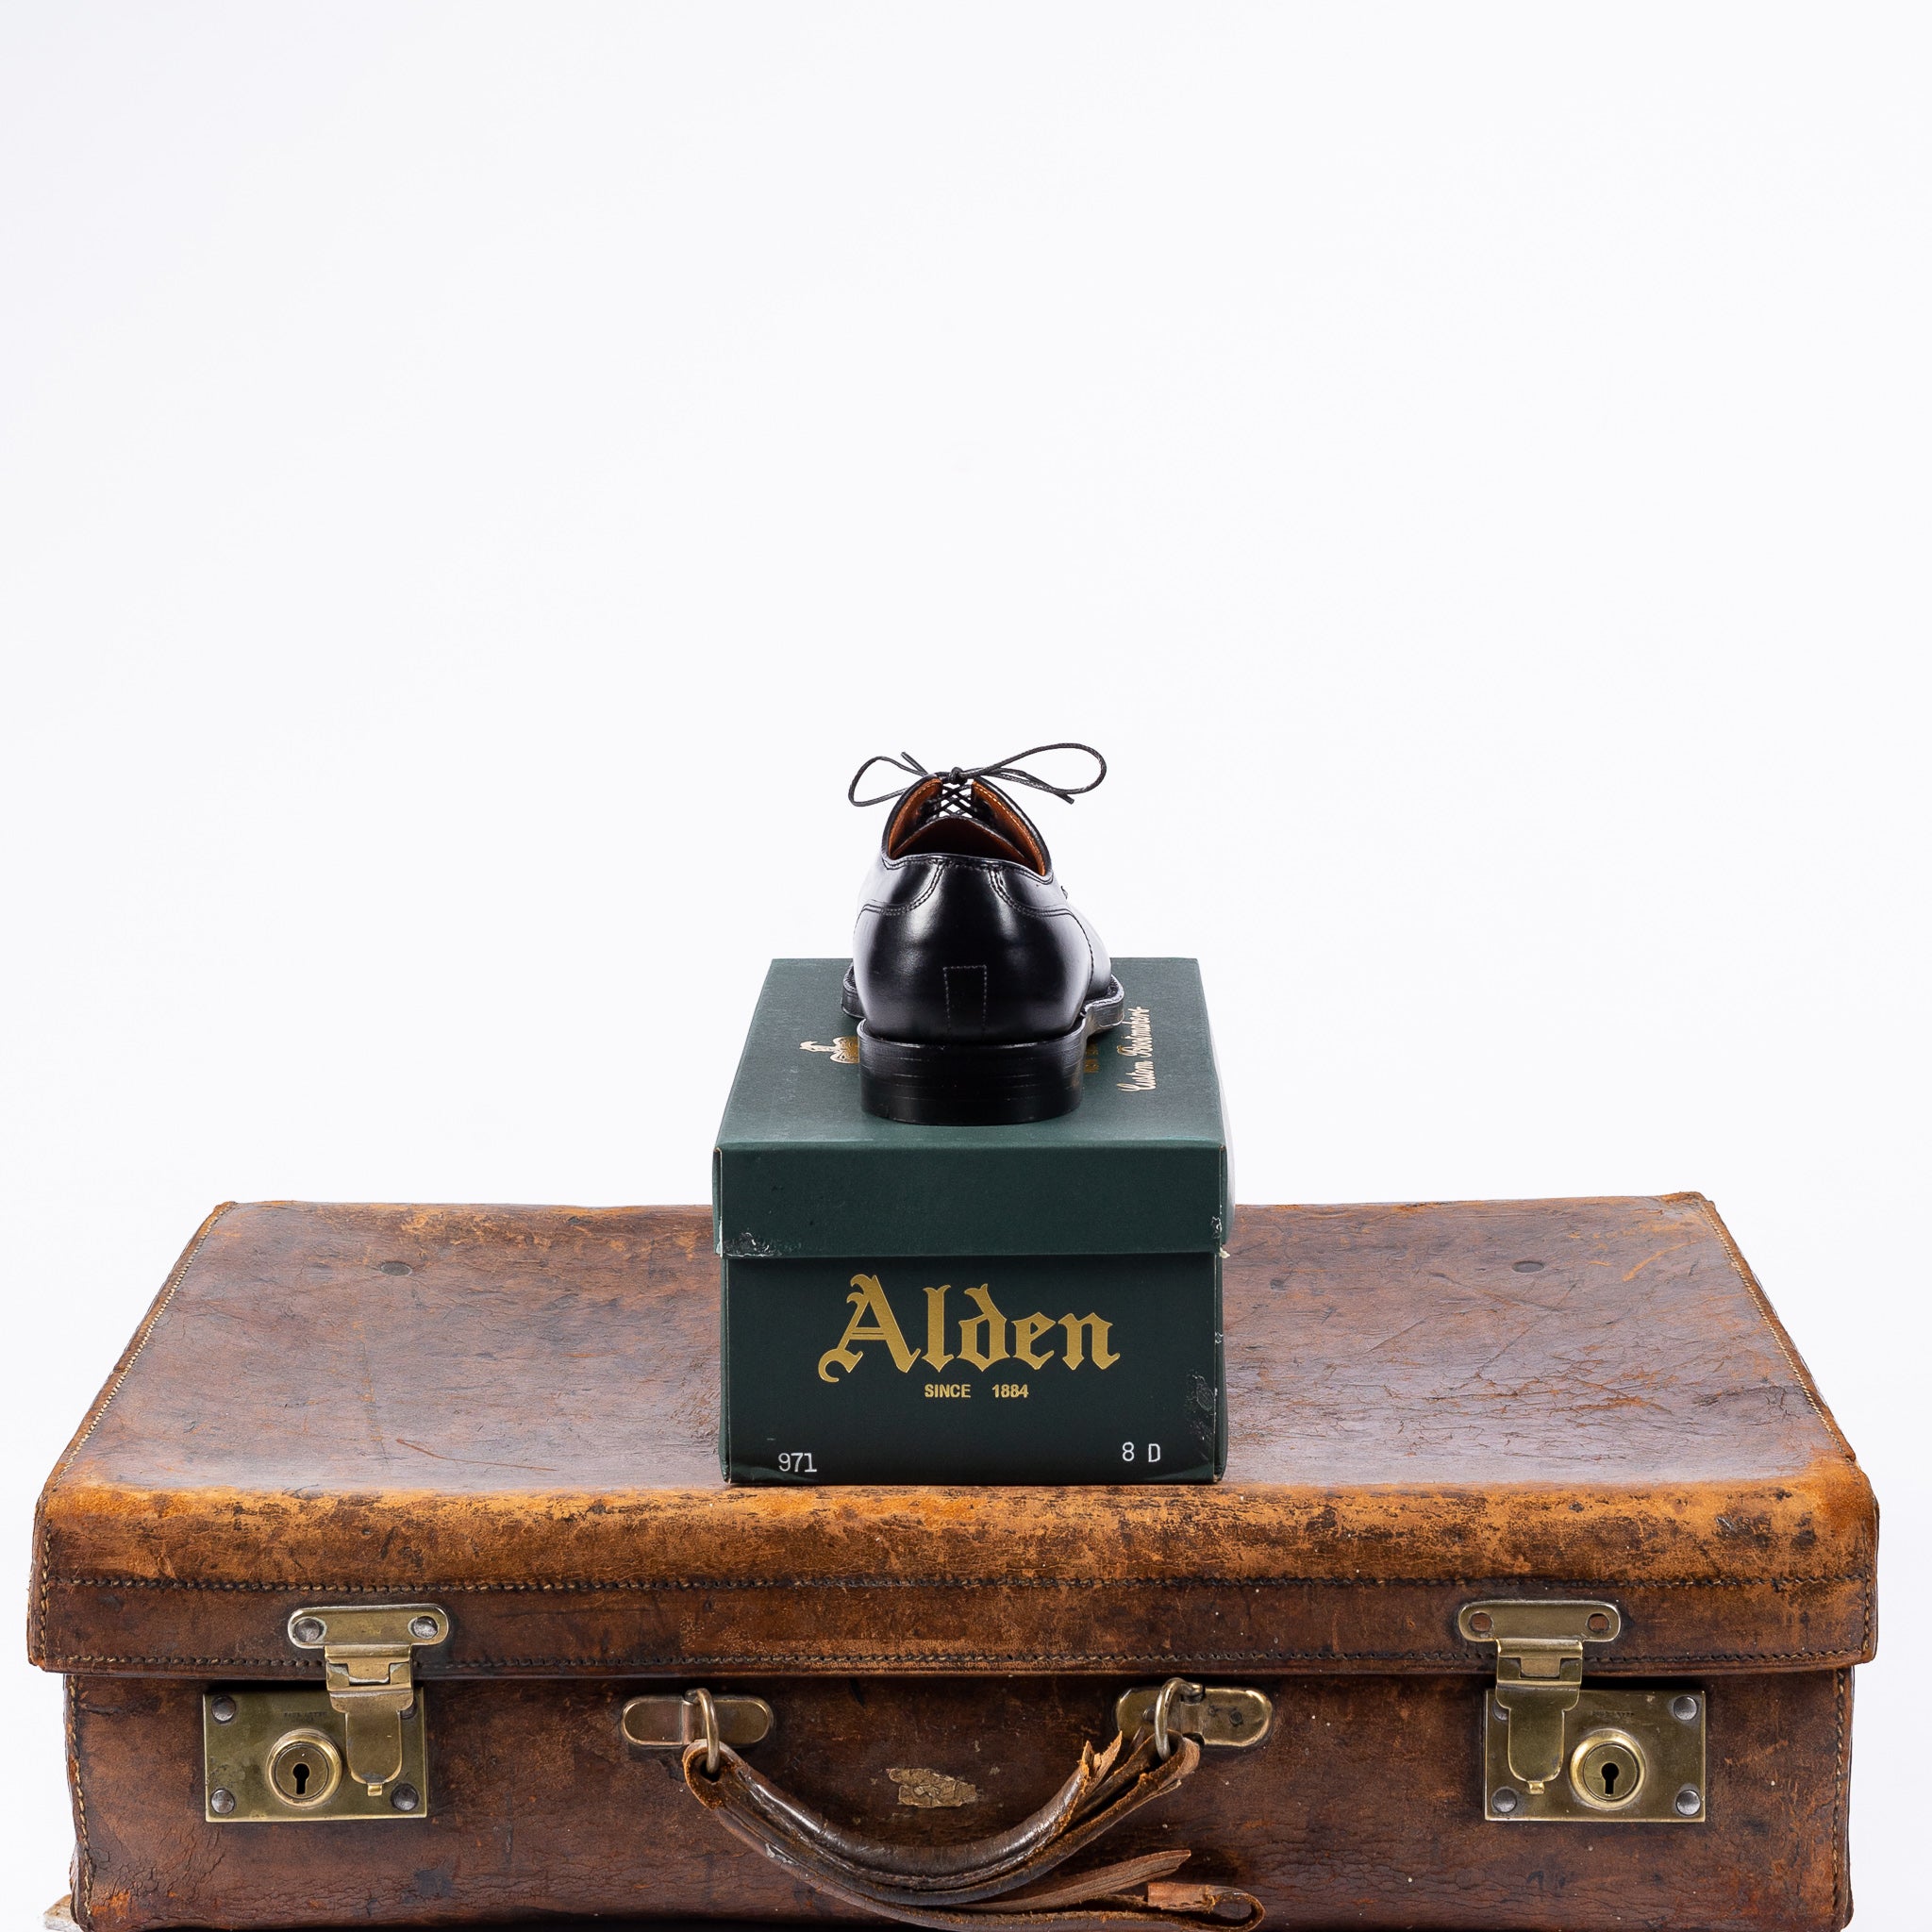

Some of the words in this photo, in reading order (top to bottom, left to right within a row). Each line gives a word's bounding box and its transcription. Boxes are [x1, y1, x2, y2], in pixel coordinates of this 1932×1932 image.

[1116, 1060, 1157, 1091] Custom
[817, 1274, 1121, 1383] Alden
[924, 1383, 972, 1399] SINCE
[991, 1383, 1029, 1399] 1884
[777, 1452, 818, 1473] 971
[1122, 1441, 1135, 1462] 8
[1147, 1442, 1161, 1463] D
